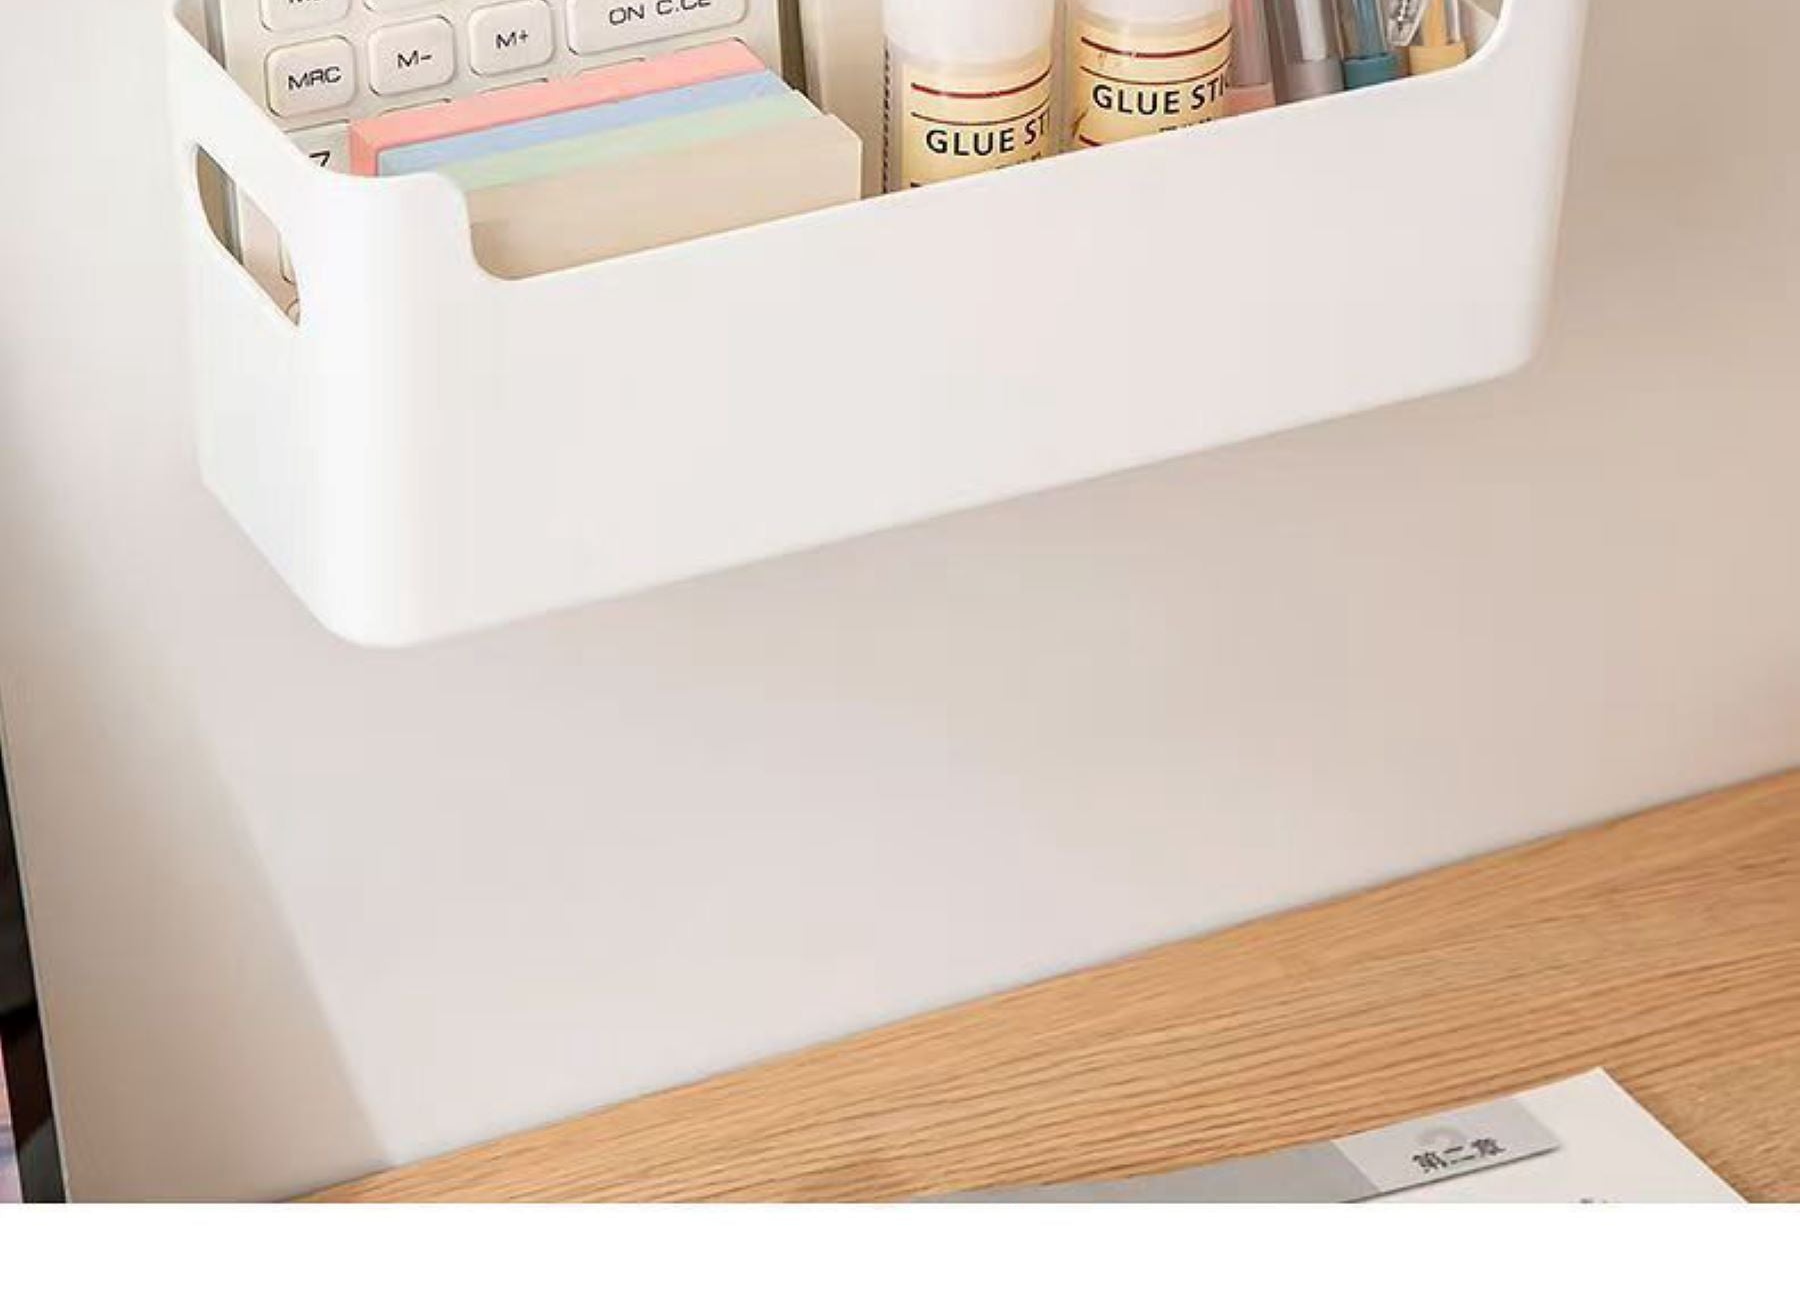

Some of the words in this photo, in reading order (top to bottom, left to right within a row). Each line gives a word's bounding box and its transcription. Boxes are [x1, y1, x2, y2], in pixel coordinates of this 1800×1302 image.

[608, 3, 646, 26] ON
[495, 30, 529, 50] M+
[287, 65, 342, 91] MRC
[1093, 84, 1181, 115] GLUE
[1191, 73, 1229, 110] STI
[926, 129, 1015, 156] GLUE
[1411, 1138, 1507, 1174] 第二章
